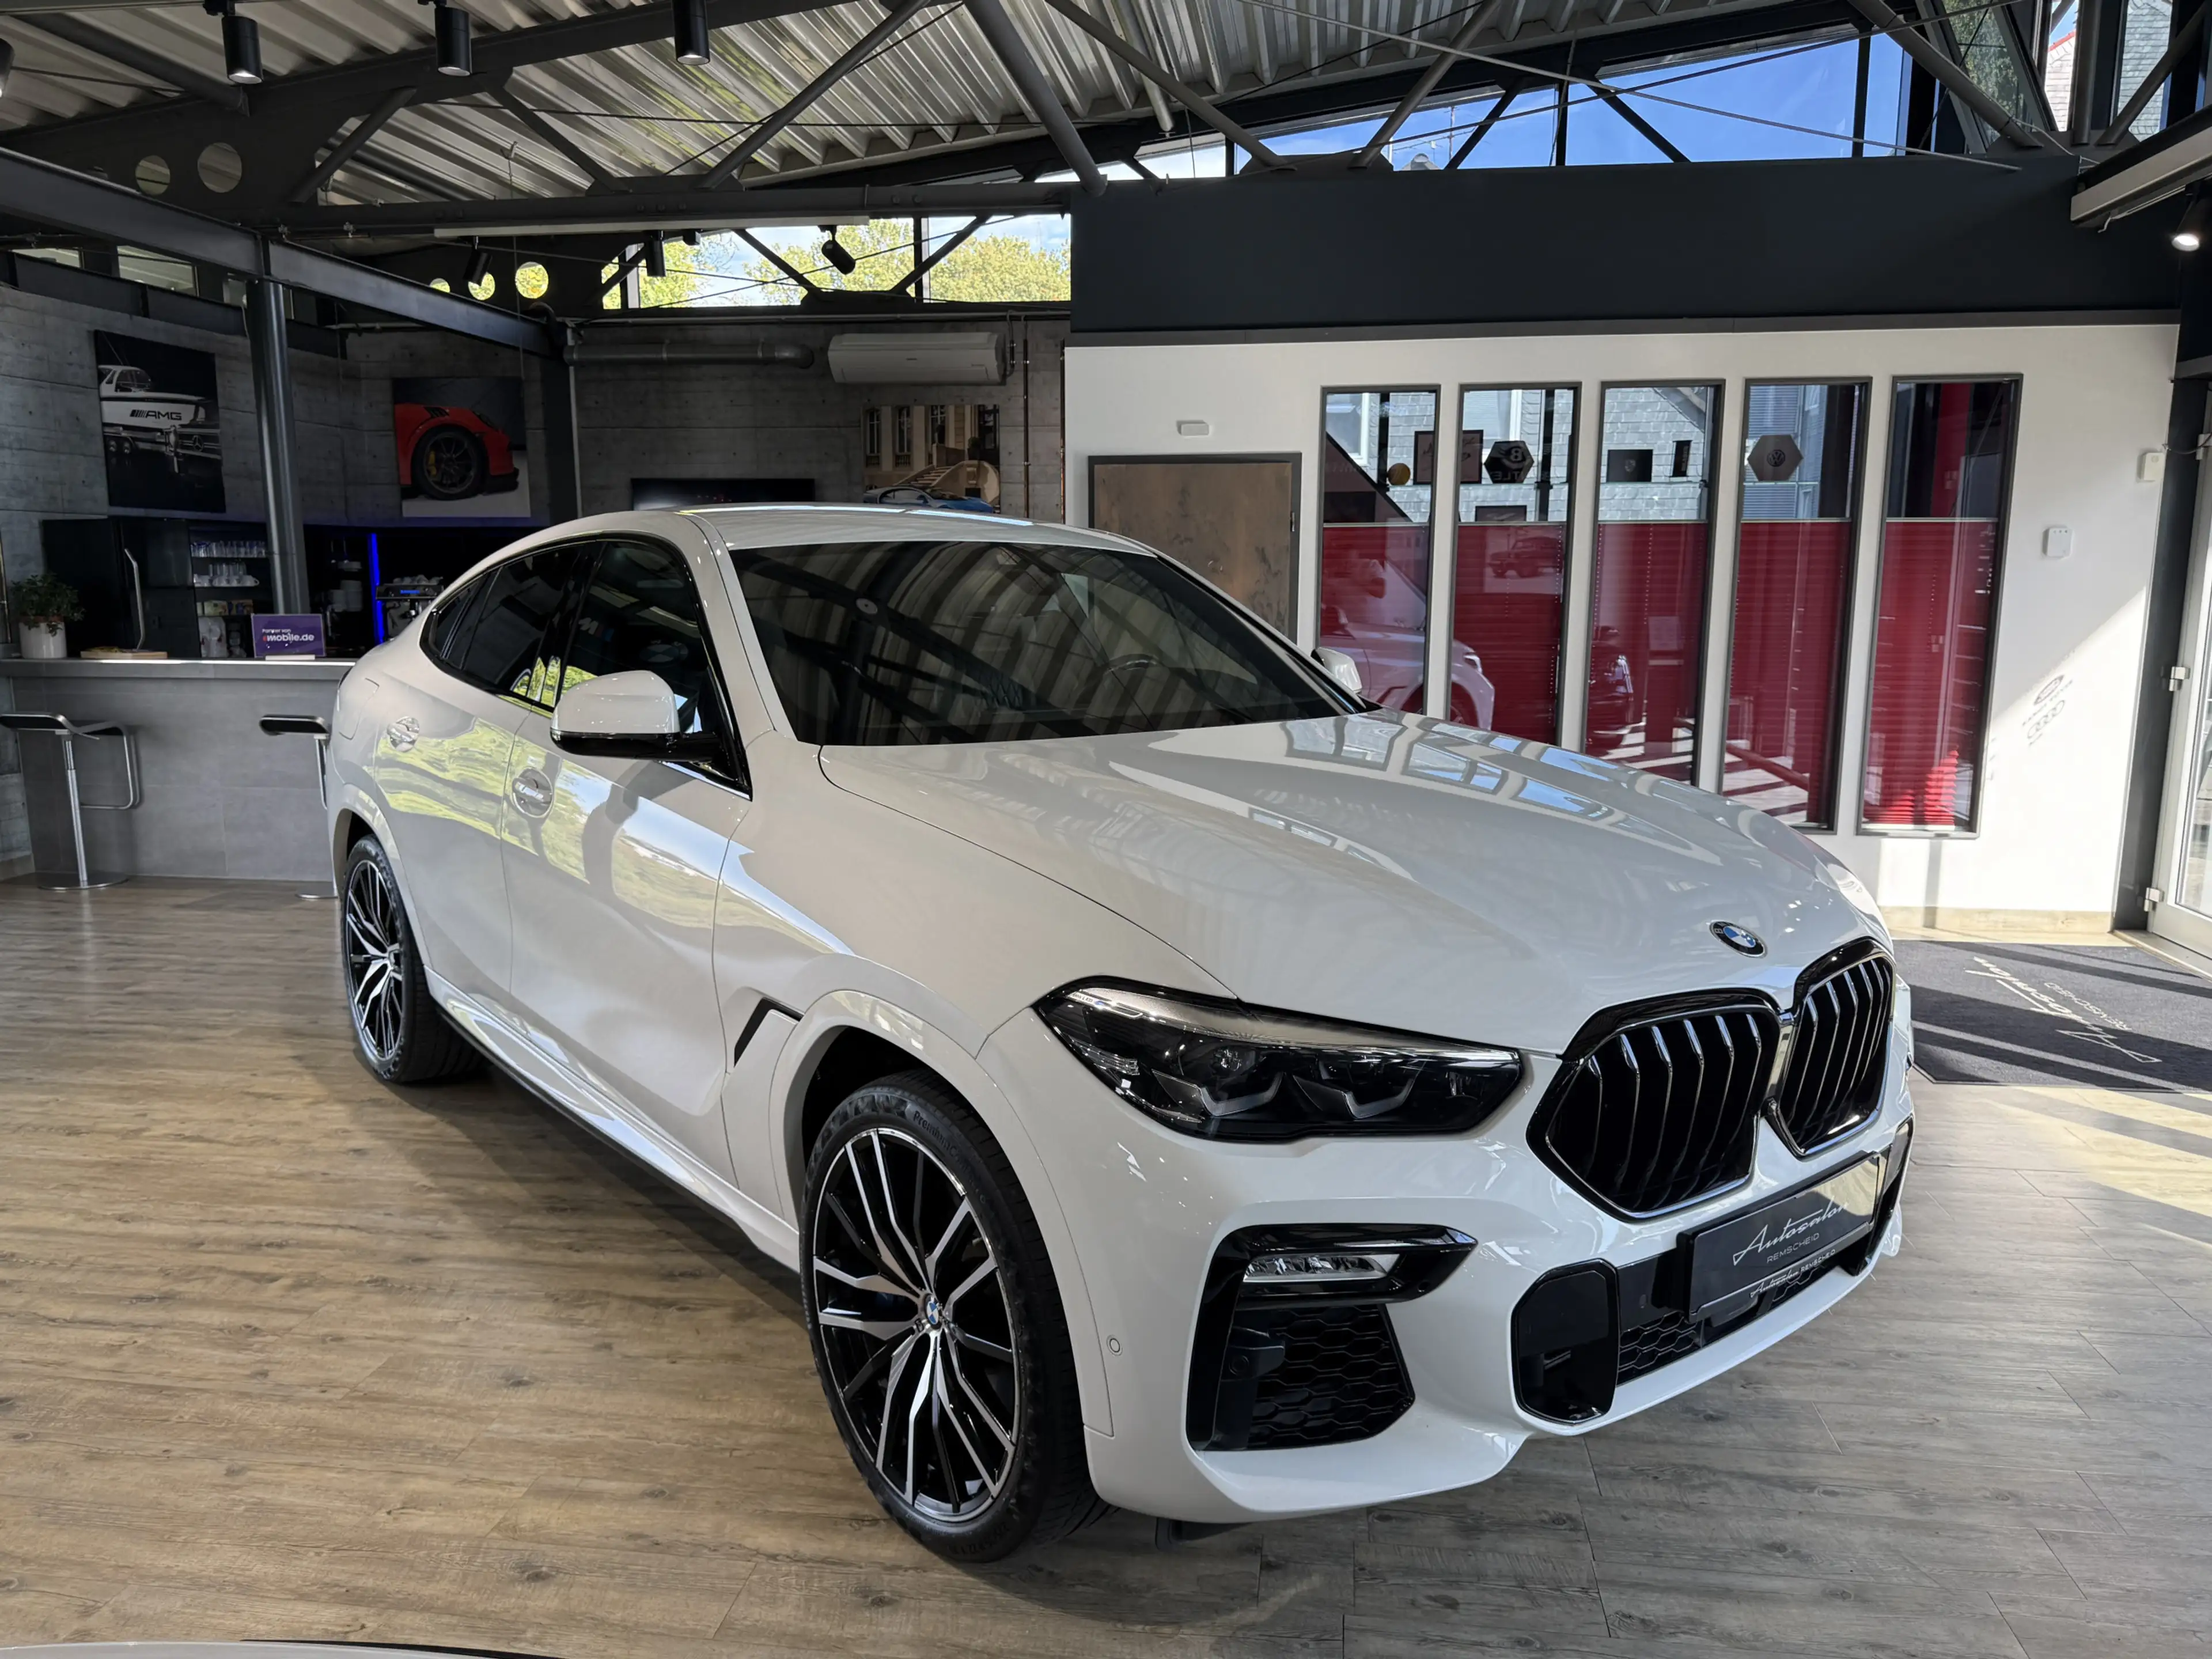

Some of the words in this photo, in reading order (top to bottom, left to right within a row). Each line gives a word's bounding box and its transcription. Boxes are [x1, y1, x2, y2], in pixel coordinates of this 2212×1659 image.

[145, 410, 182, 421] AMG
[267, 634, 315, 642] mobile.de
[1733, 1195, 1849, 1266] Autosalon
[1767, 1232, 1820, 1264] REMSCHEID
[1801, 1248, 1836, 1272] REMSCHEID
